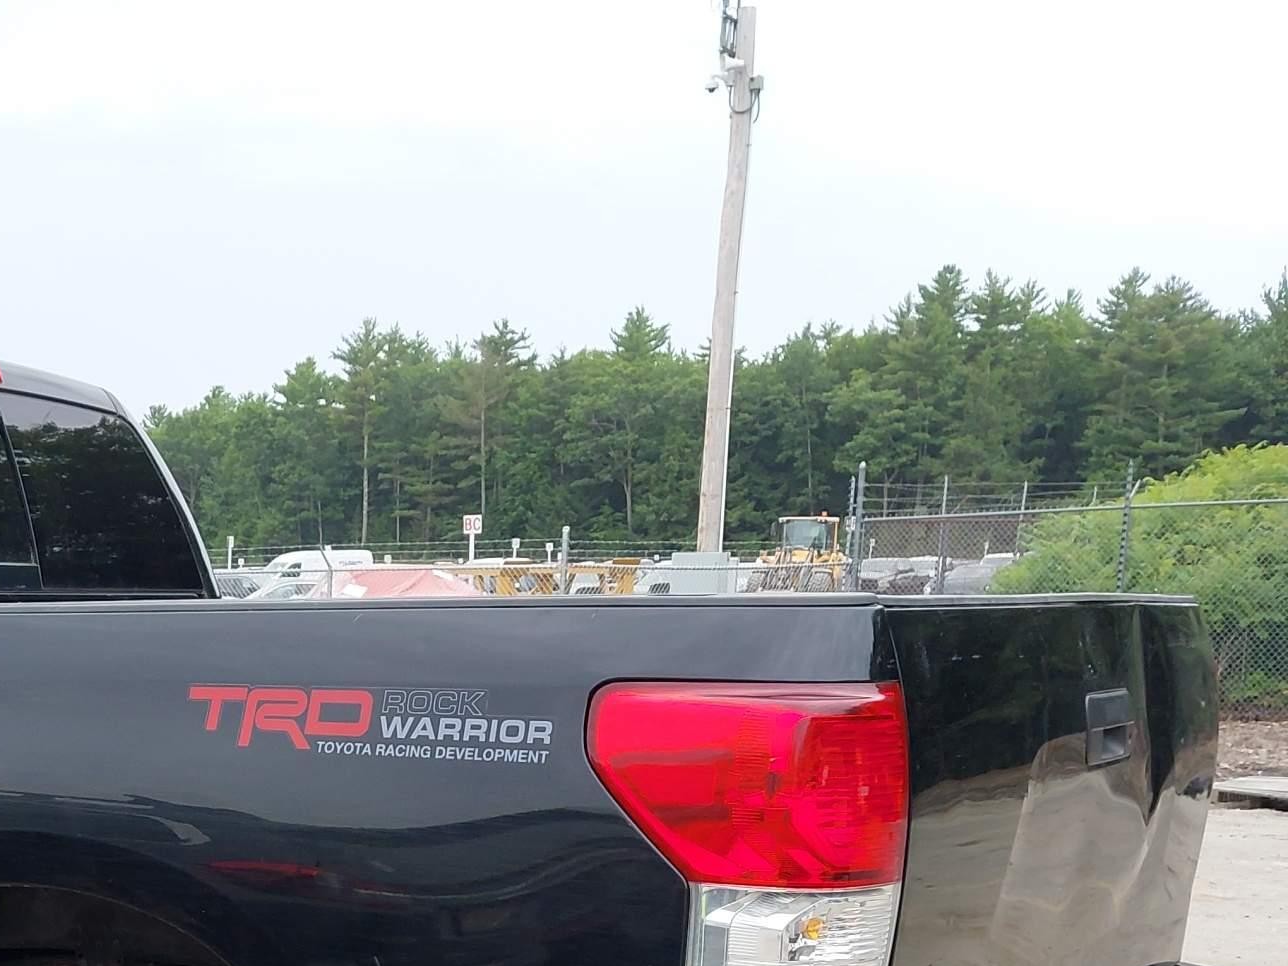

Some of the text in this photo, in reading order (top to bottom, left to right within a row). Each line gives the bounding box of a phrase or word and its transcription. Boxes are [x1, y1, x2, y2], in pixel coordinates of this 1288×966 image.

[465, 517, 481, 531] BC
[382, 689, 486, 716] ROCK
[189, 686, 373, 750] TRD
[380, 715, 553, 745] WARRIOR
[316, 741, 550, 764] TOYOTA RACING DEVELOPMENT
